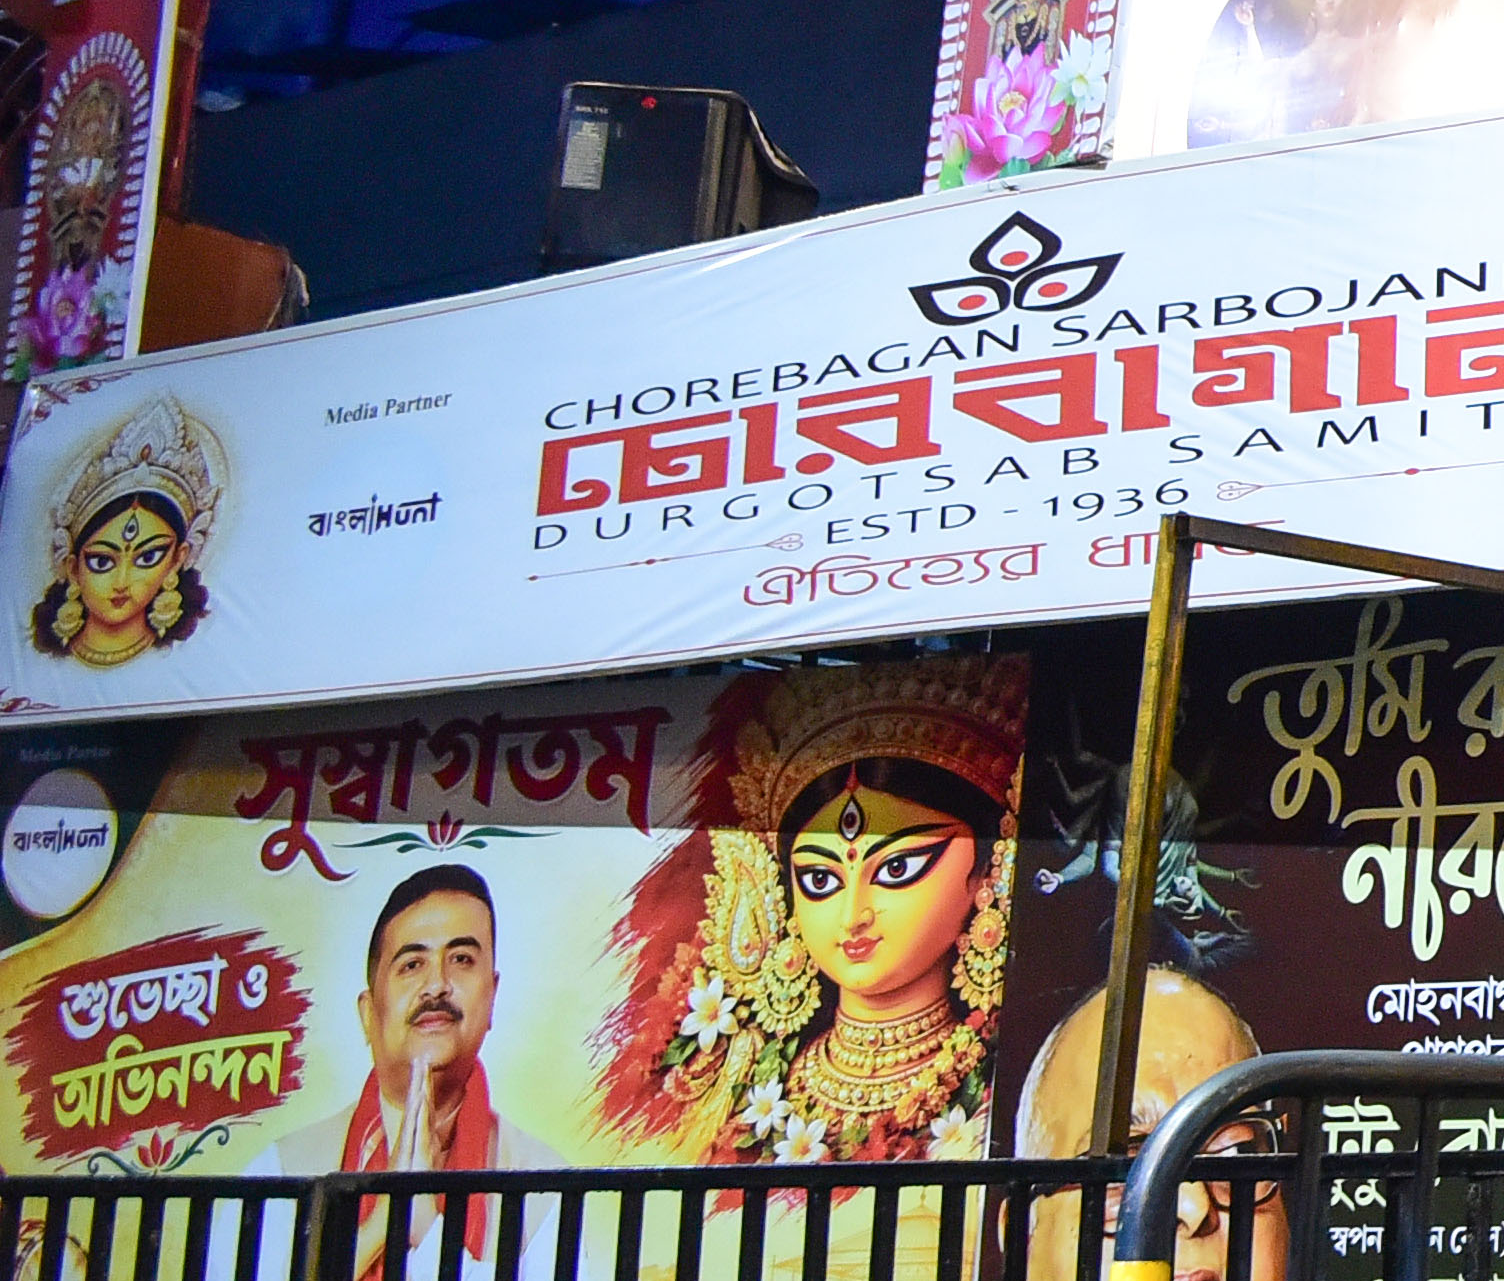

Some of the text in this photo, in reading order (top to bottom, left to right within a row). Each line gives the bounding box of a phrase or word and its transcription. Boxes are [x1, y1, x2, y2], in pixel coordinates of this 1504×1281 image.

[325, 390, 452, 427] Media Partner
[544, 323, 1020, 431] CHOREBAGAN
[533, 446, 1099, 550] DURGOTSAB
[826, 502, 977, 545] ESTD
[1042, 477, 1190, 522] 1936
[1227, 599, 1451, 825] তুমি
[234, 706, 673, 882] সুস্বাগতম
[58, 953, 269, 1041] শুভেচ্ছা ও
[52, 1030, 292, 1129] অভিনন্দন
